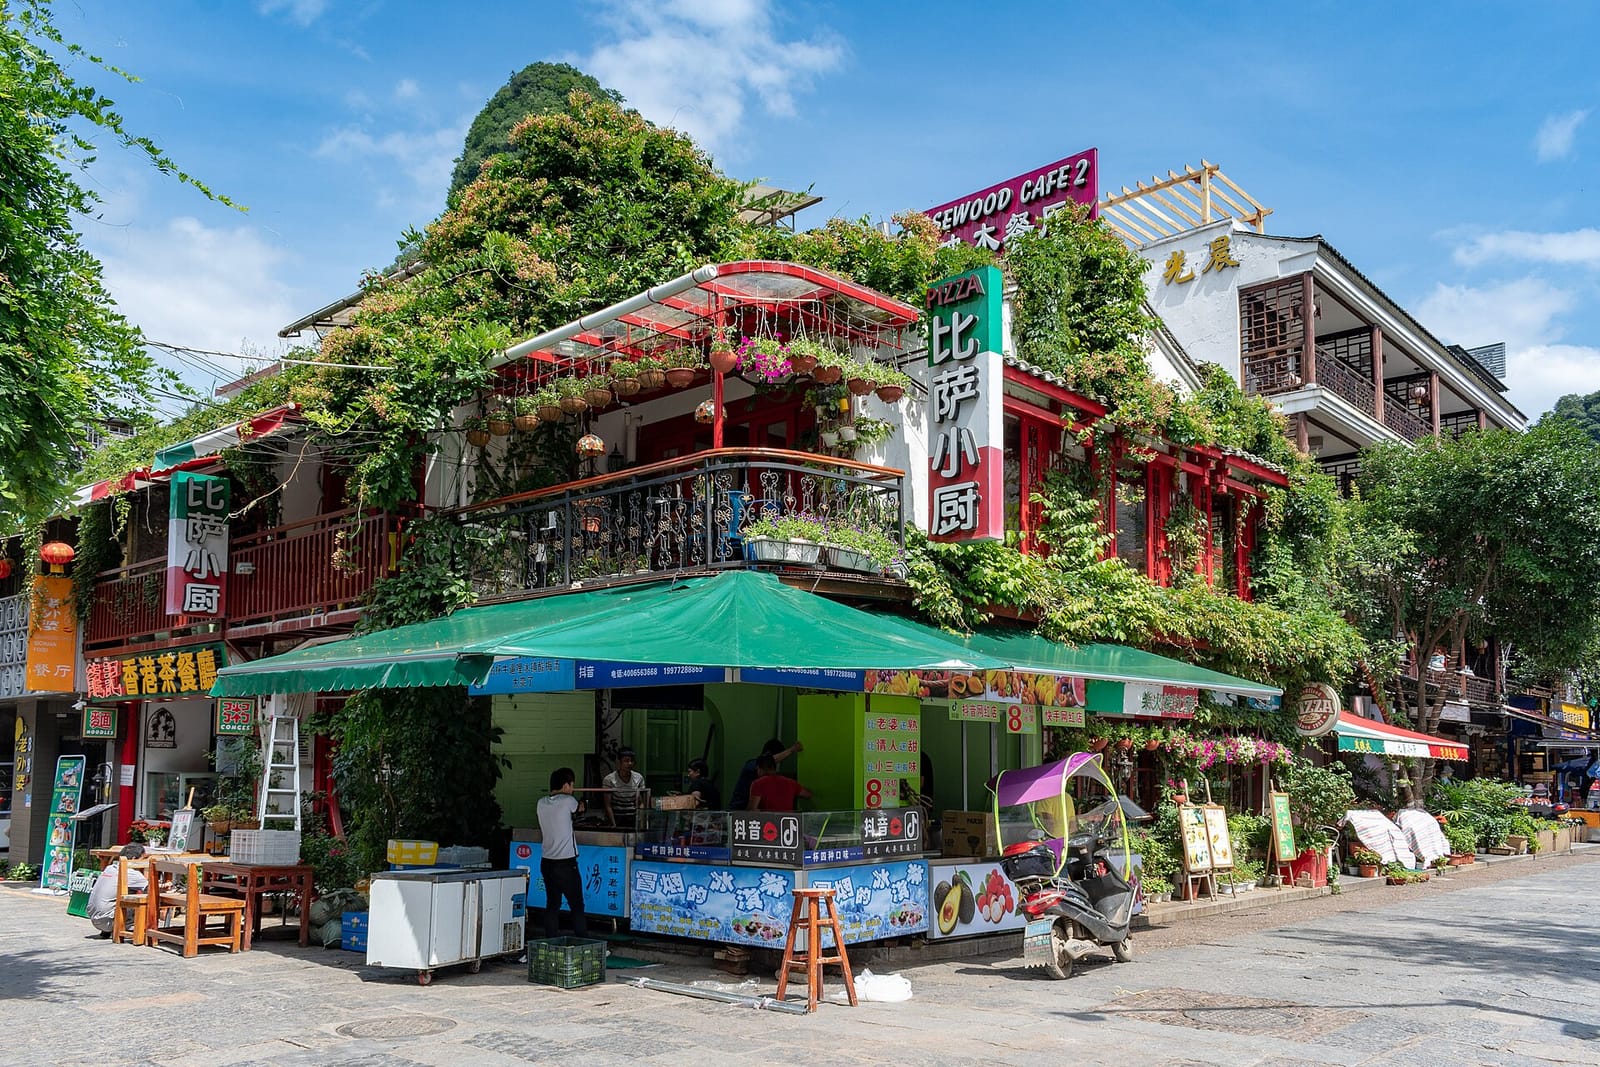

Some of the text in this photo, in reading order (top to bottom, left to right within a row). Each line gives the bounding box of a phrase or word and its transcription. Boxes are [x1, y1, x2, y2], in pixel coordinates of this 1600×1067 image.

[932, 158, 1089, 231] SEWOOD CAFE 2
[926, 274, 984, 309] PIZZA
[931, 311, 981, 536] 比萨小厨
[183, 477, 225, 614] 比萨小厨
[33, 663, 72, 678] 餐厅
[578, 665, 595, 679] 抖音
[1008, 704, 1022, 731] 8
[865, 778, 882, 808] 8
[734, 819, 761, 841] 抖音
[864, 816, 888, 838] 抖音
[643, 846, 691, 857] 一杯四种口味
[804, 850, 849, 862] 一杯四种口味
